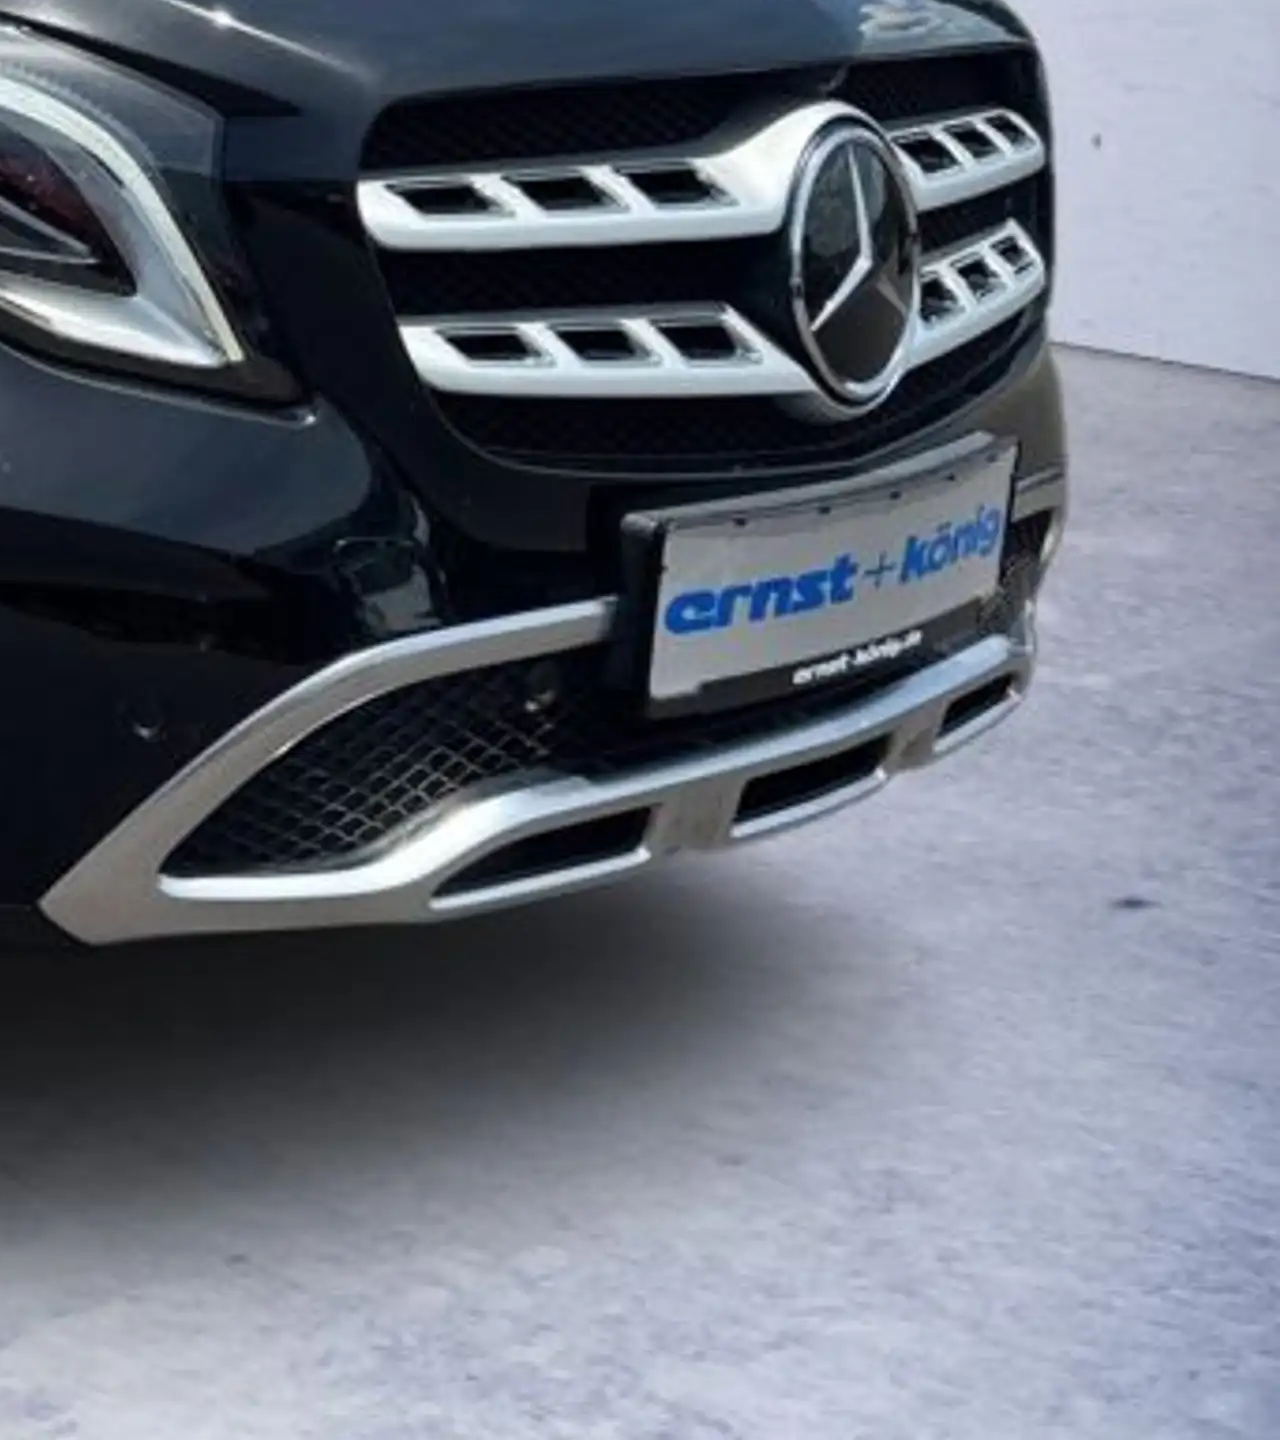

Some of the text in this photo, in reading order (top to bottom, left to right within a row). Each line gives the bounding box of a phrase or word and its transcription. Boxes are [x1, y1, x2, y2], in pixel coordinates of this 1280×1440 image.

[665, 503, 1001, 634] ernst + könig
